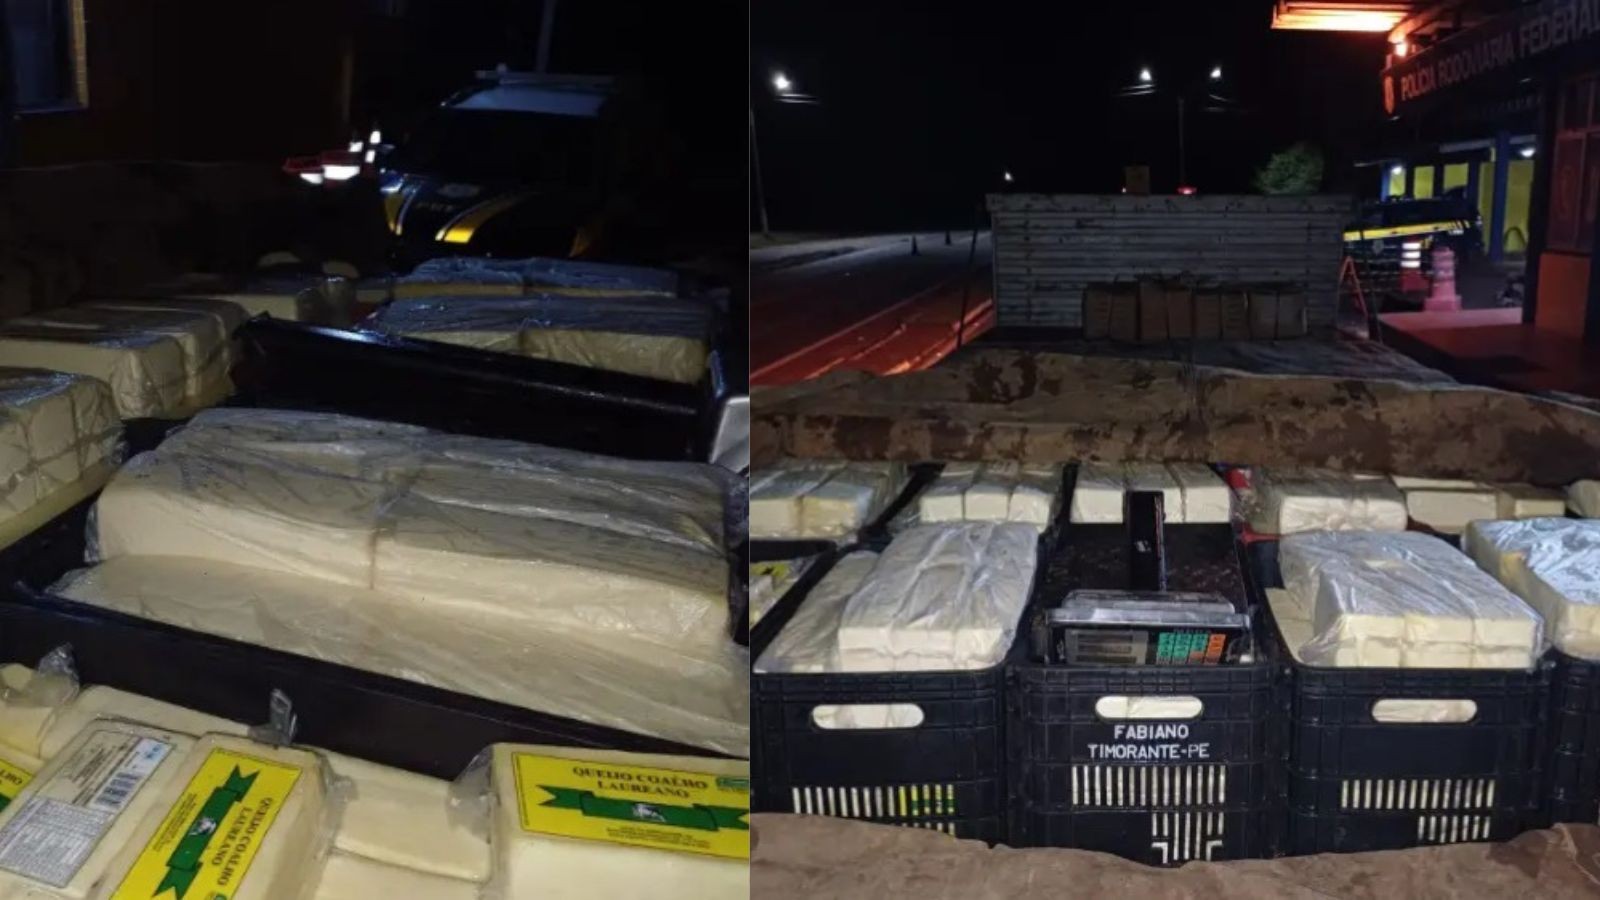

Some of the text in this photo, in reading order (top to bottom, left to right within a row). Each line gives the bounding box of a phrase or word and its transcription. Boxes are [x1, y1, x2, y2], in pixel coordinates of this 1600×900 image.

[1113, 724, 1190, 740] FABIANO
[1087, 743, 1211, 760] TIMORANTE-PE
[597, 780, 690, 799] LAUREANO
